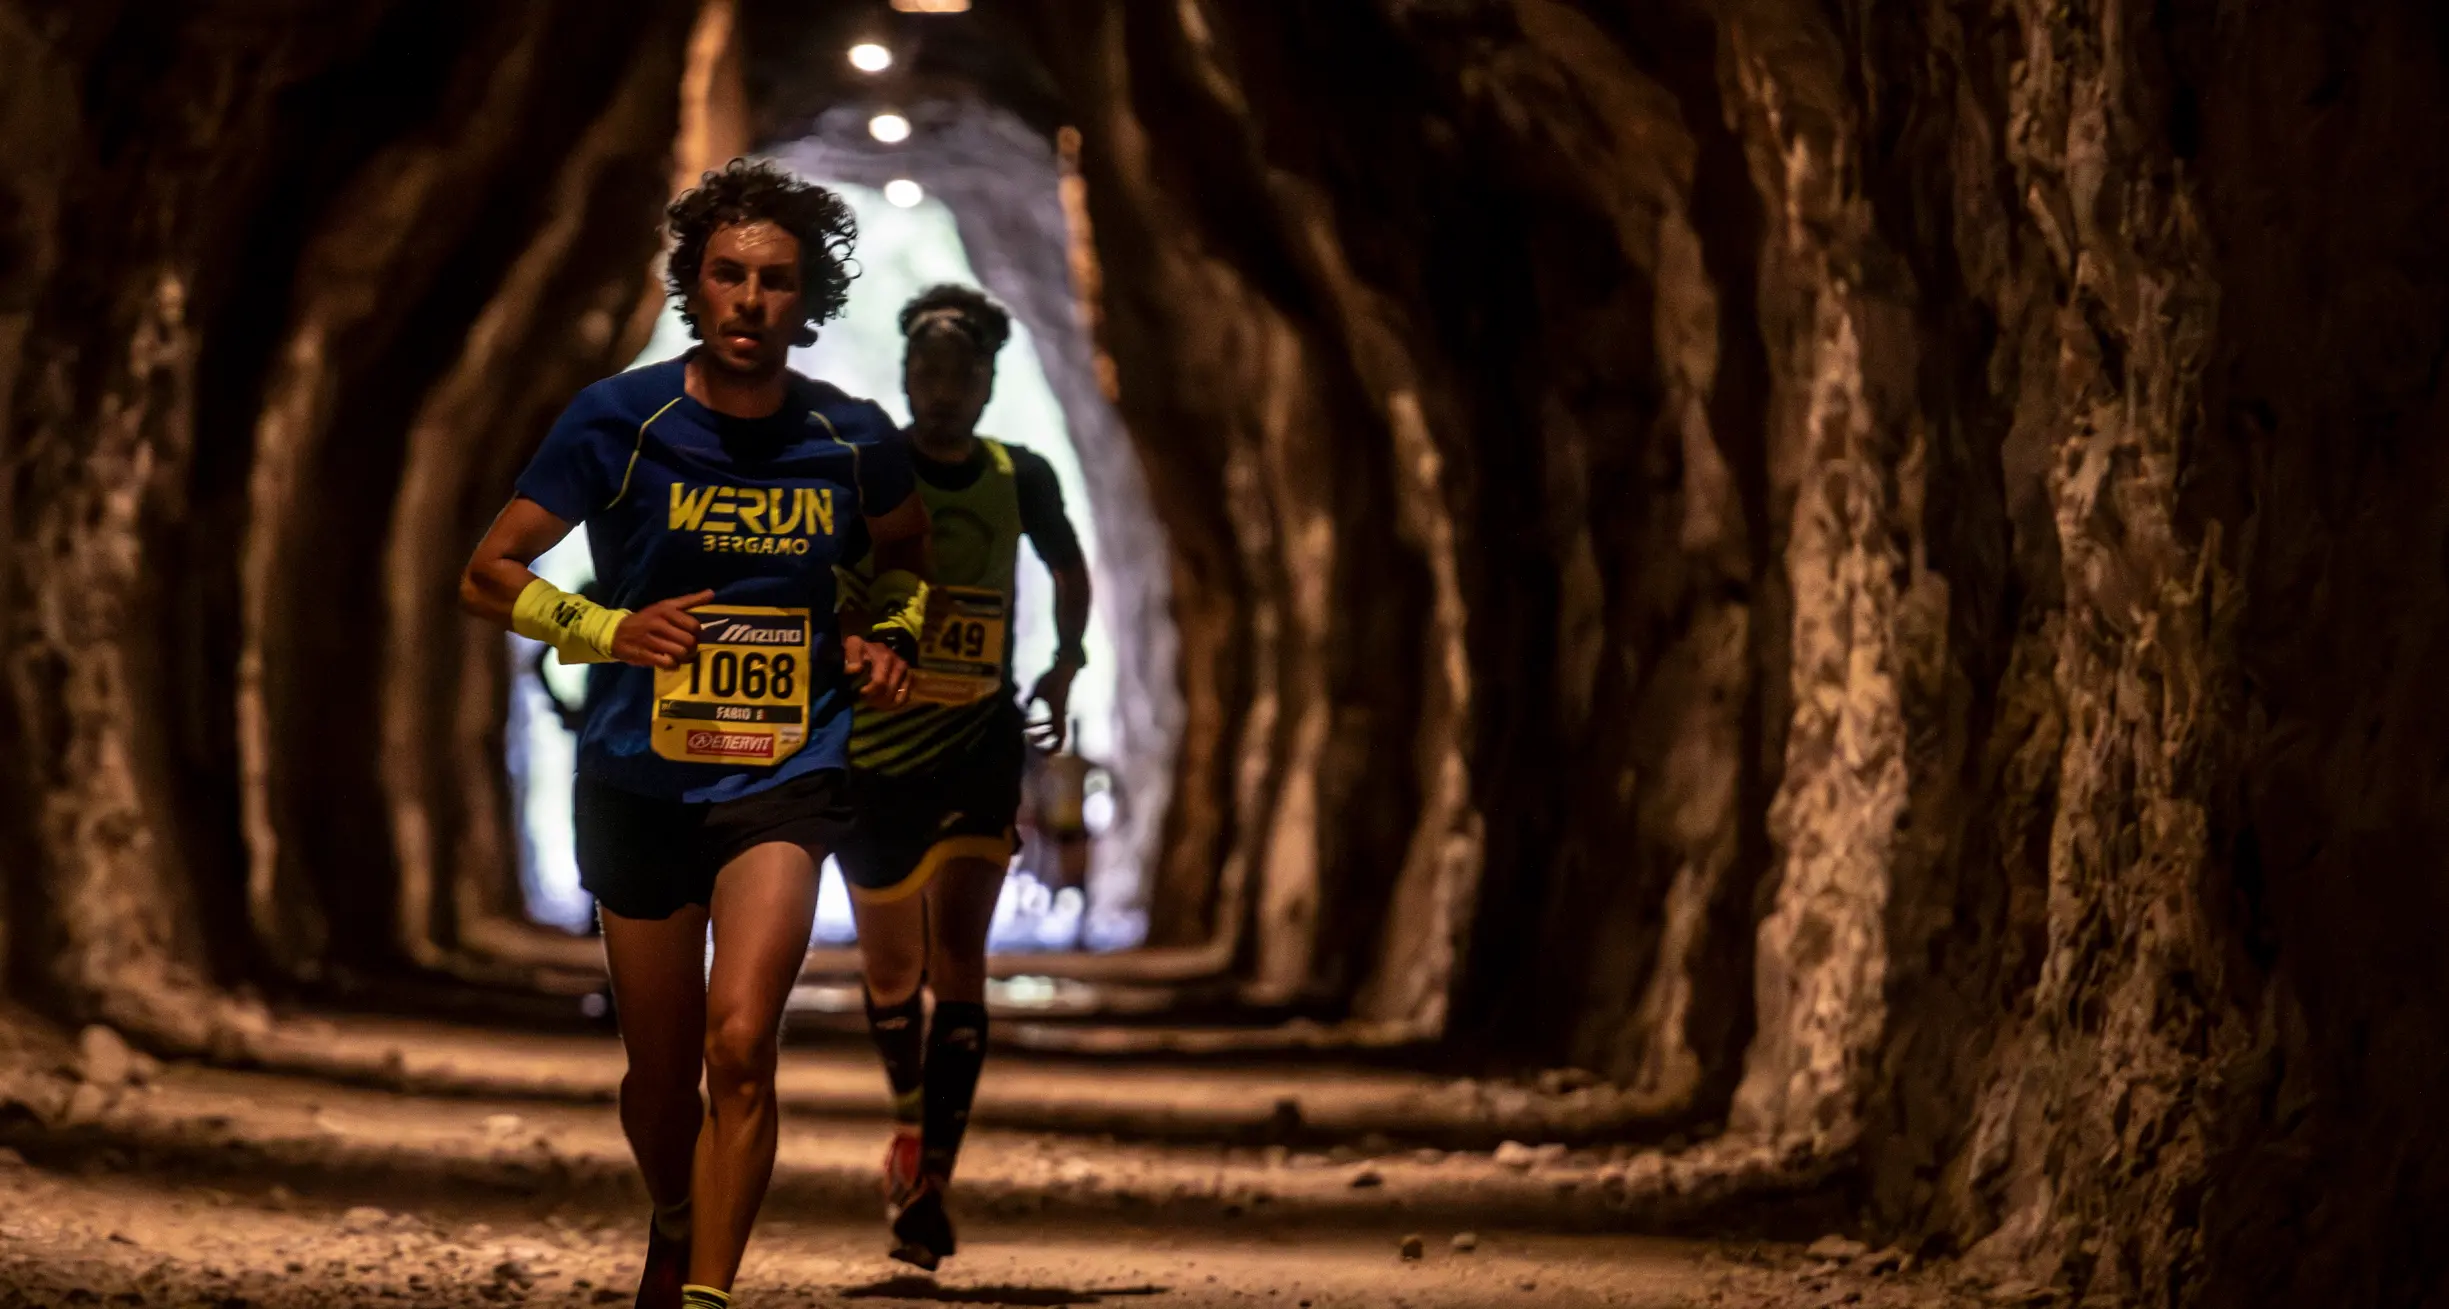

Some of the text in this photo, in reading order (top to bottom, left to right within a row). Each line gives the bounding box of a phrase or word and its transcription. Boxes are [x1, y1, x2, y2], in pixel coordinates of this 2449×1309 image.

[668, 482, 834, 536] WERUN
[703, 535, 810, 555] BERGAMO
[717, 624, 802, 643] MIZUNO
[925, 622, 985, 657] 49
[690, 651, 795, 699] 1068
